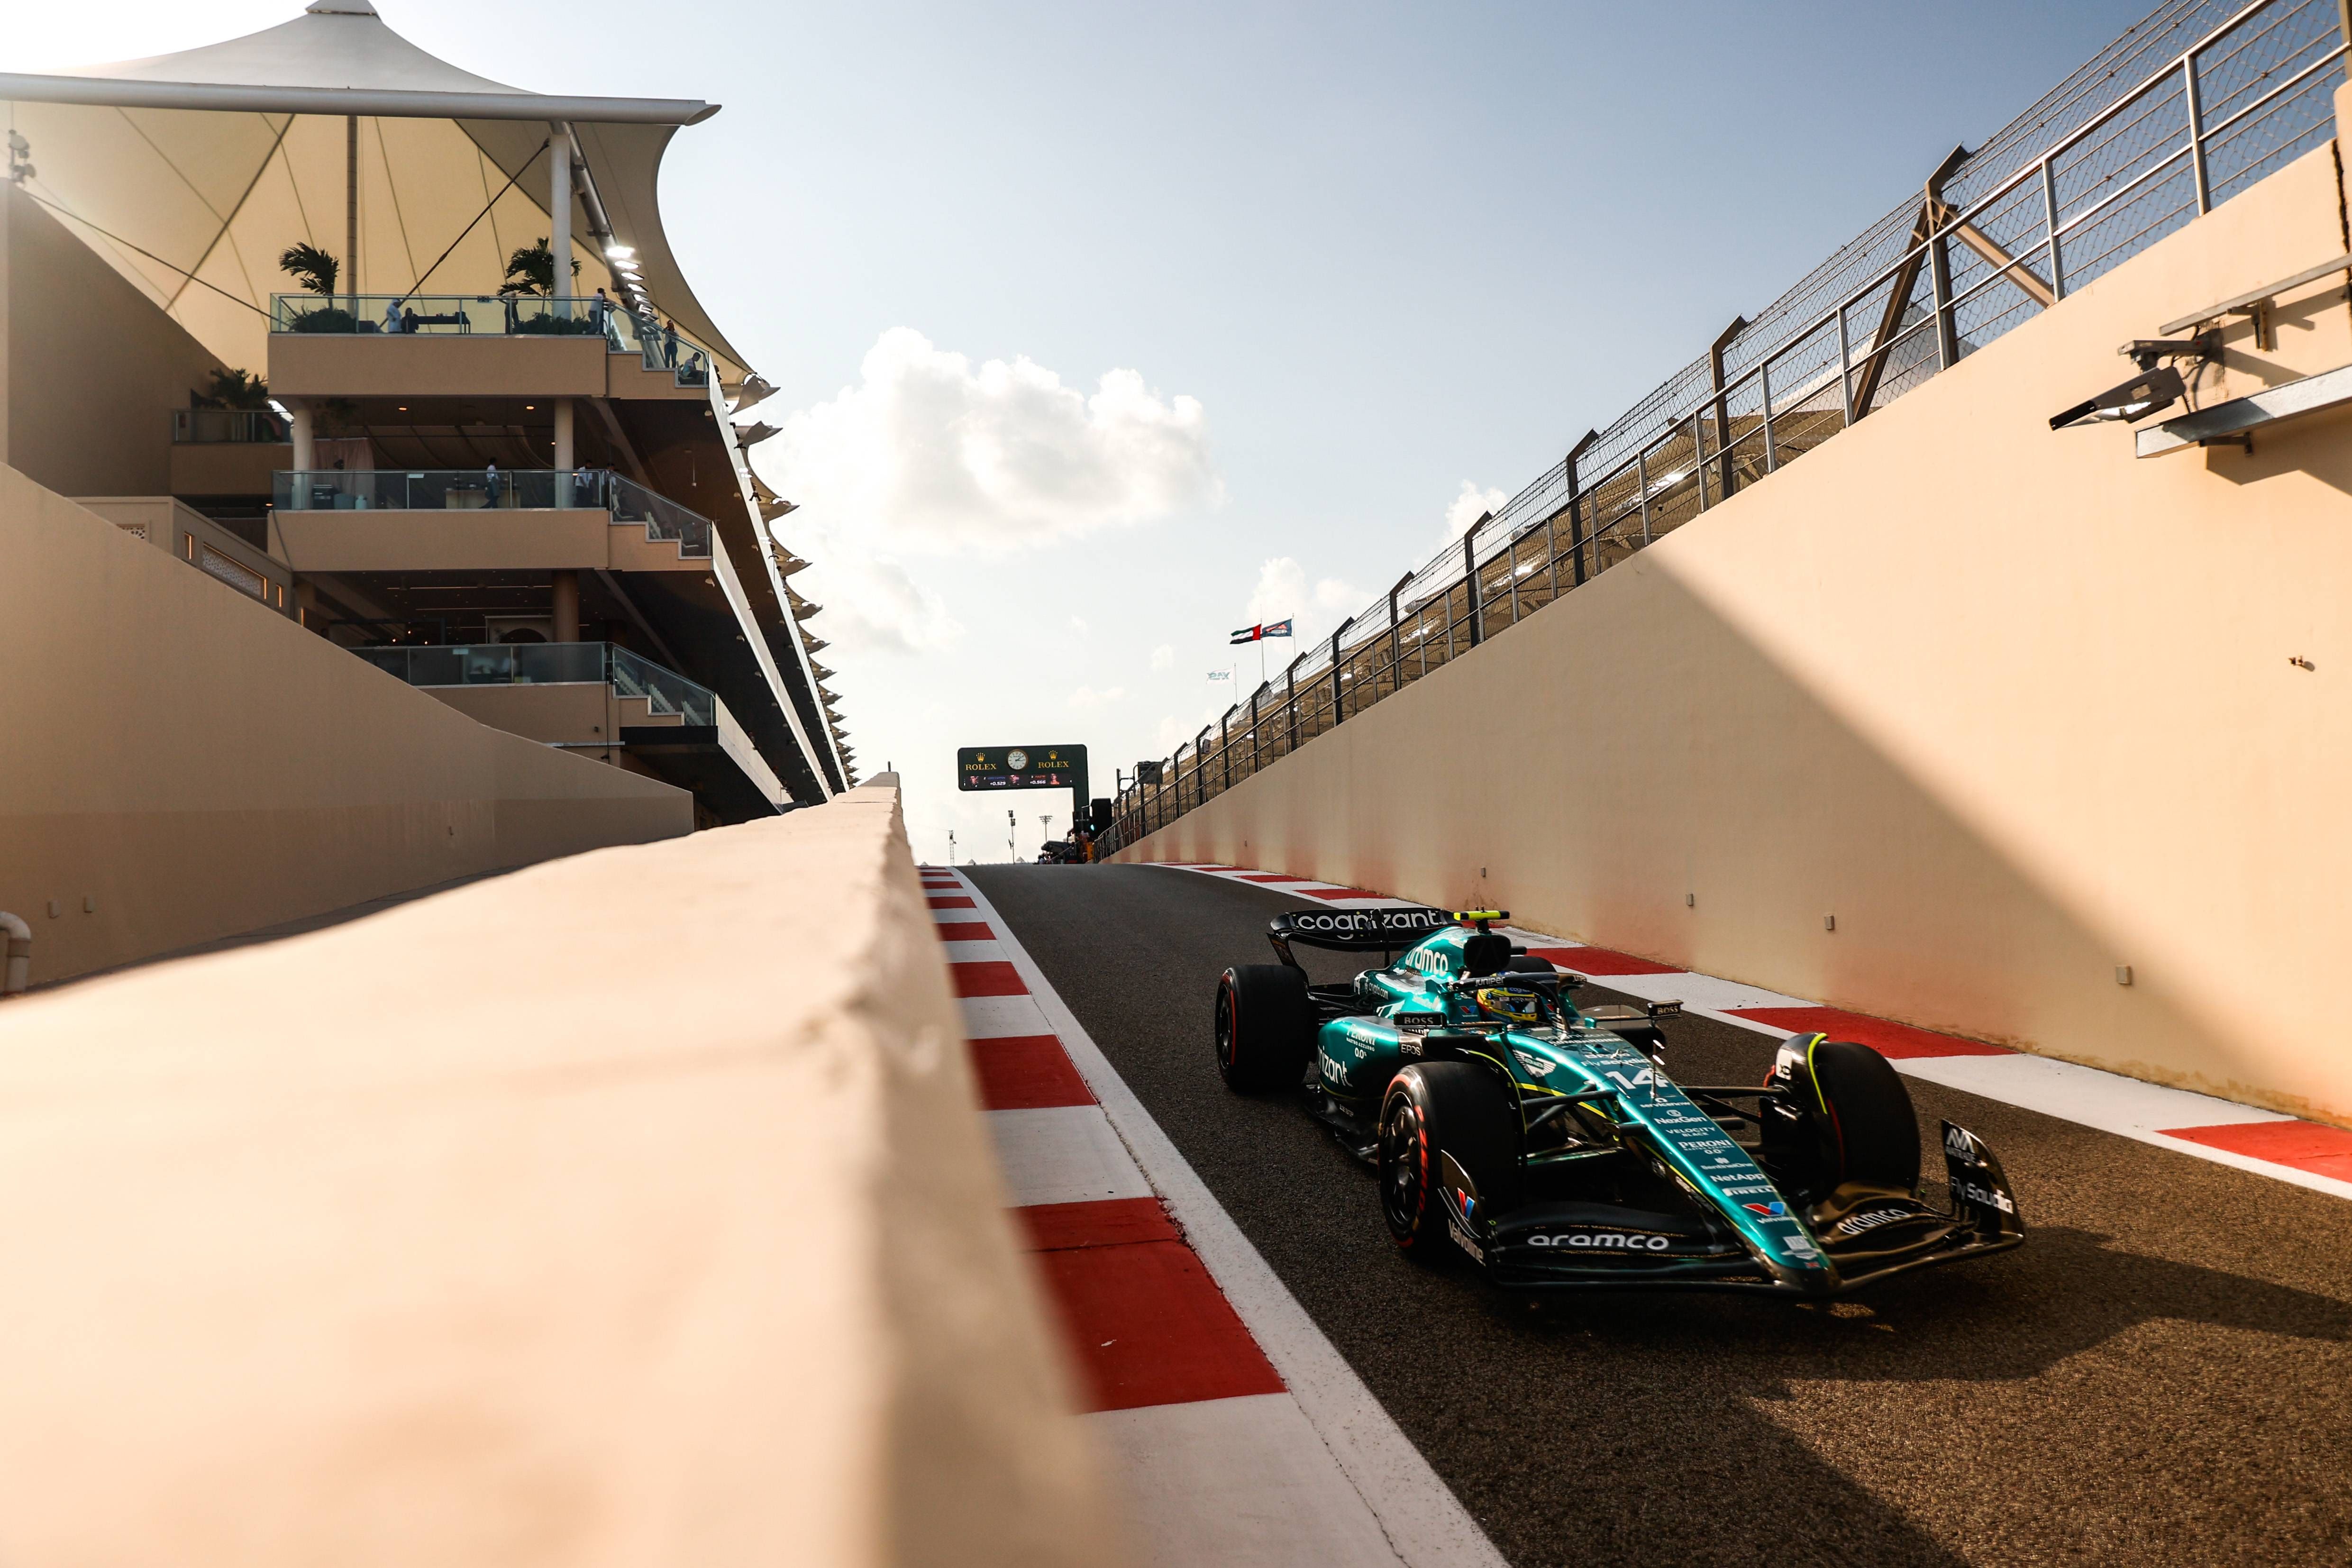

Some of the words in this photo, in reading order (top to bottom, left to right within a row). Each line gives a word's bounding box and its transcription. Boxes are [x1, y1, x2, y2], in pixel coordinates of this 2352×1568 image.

[1298, 910, 1439, 939] cognizant
[1405, 947, 1448, 976] aramco
[1657, 1005, 1678, 1014] BOSS
[1605, 1070, 1668, 1089] 14
[1677, 1140, 1732, 1149] PERONI
[1710, 1173, 1766, 1182] NetApp
[1838, 1209, 1910, 1235] aramco
[1527, 1234, 1669, 1250] aramco
